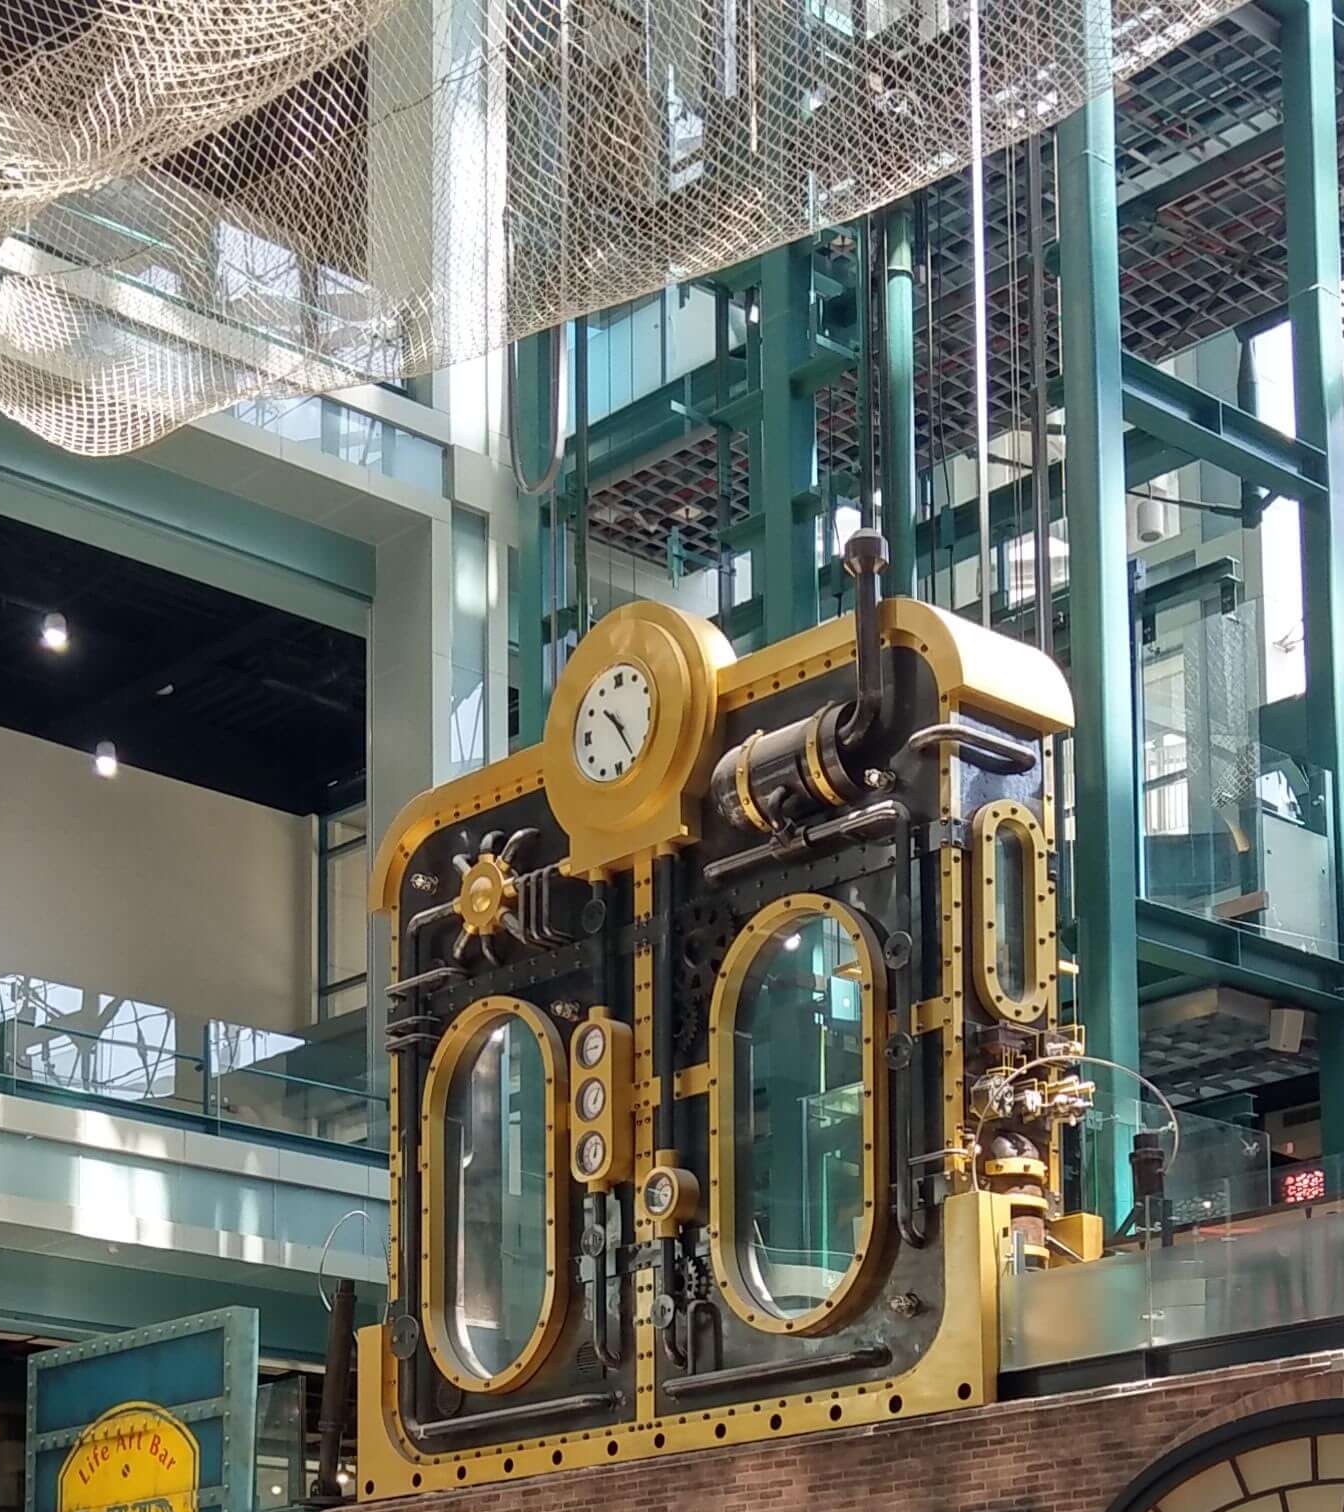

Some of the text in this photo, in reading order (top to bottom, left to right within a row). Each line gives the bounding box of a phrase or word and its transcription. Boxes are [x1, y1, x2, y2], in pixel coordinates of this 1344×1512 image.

[78, 1431, 176, 1485] Life Art Bar
